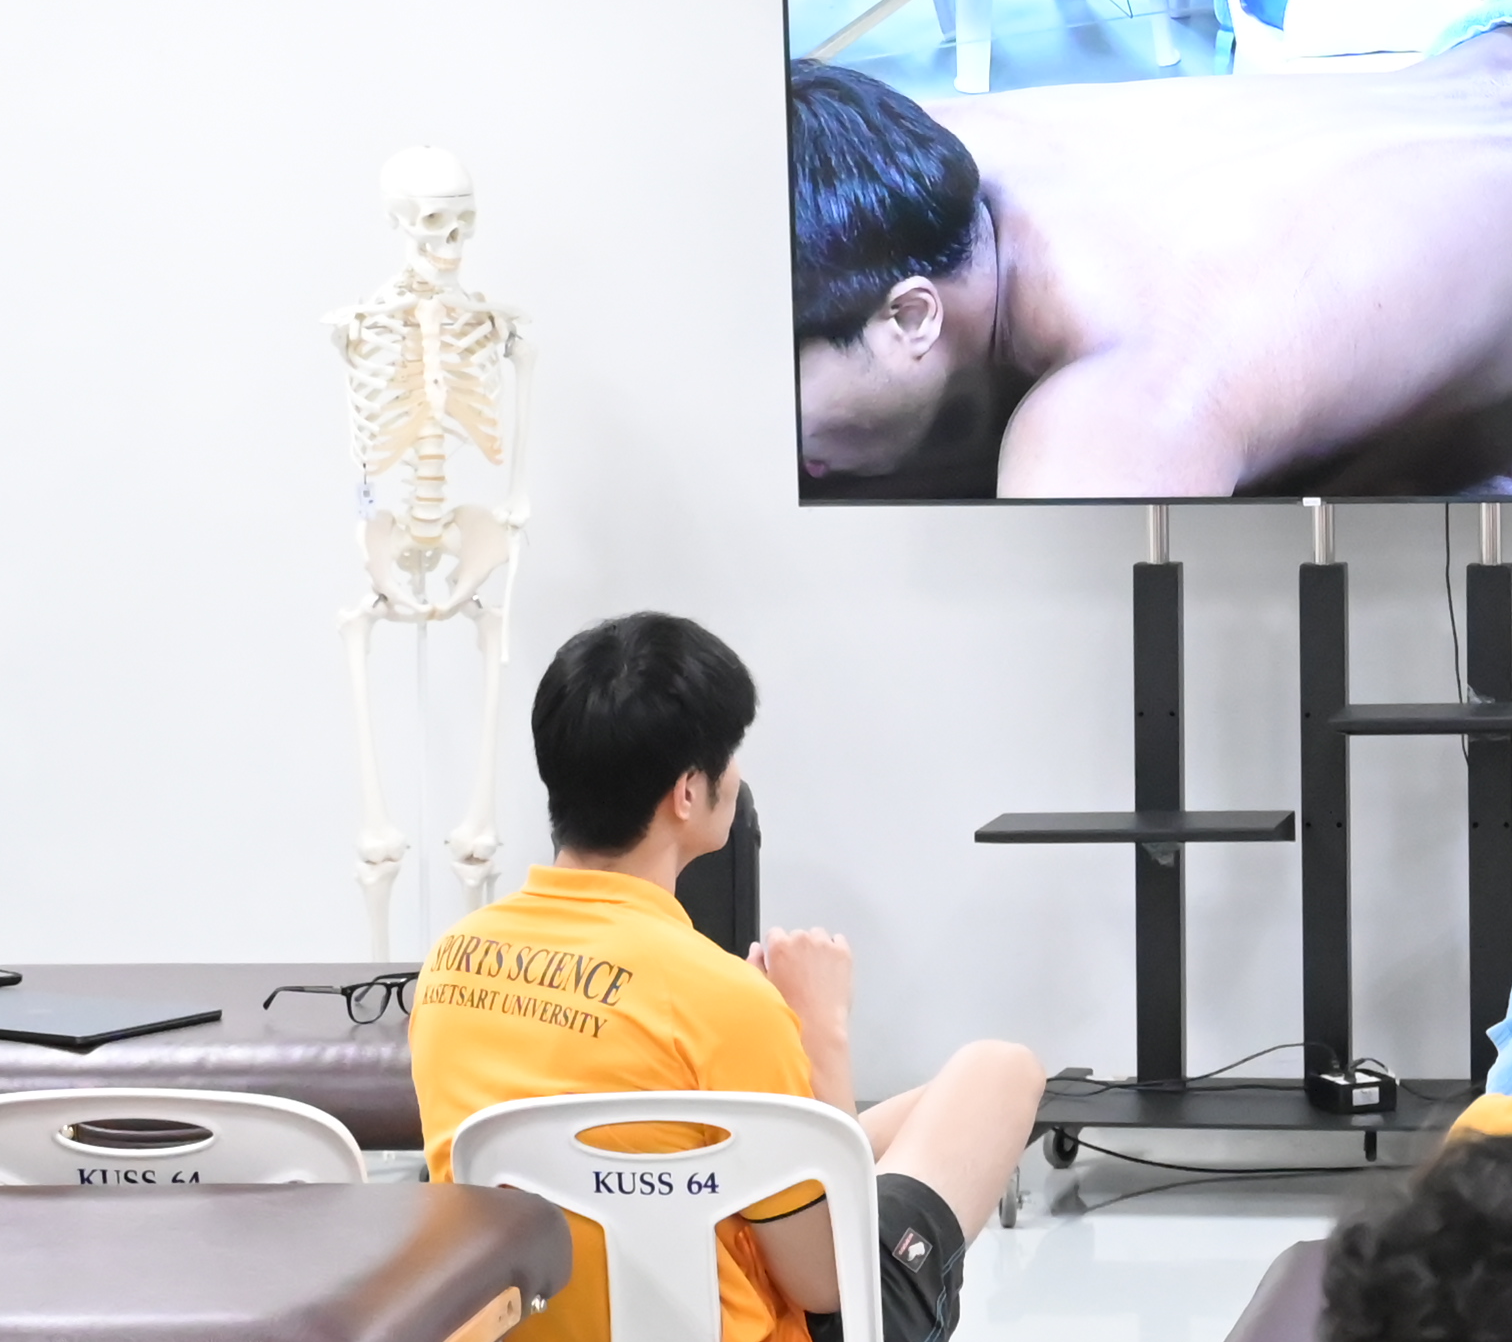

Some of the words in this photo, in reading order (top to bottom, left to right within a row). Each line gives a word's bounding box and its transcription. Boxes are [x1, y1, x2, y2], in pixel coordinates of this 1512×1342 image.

[430, 934, 512, 978] SPORTS
[507, 945, 634, 1007] SCIENCE
[422, 983, 500, 1011] KASETSART
[501, 992, 608, 1039] UNIVERSITY
[592, 1170, 674, 1196] KUSS
[686, 1171, 720, 1196] 64
